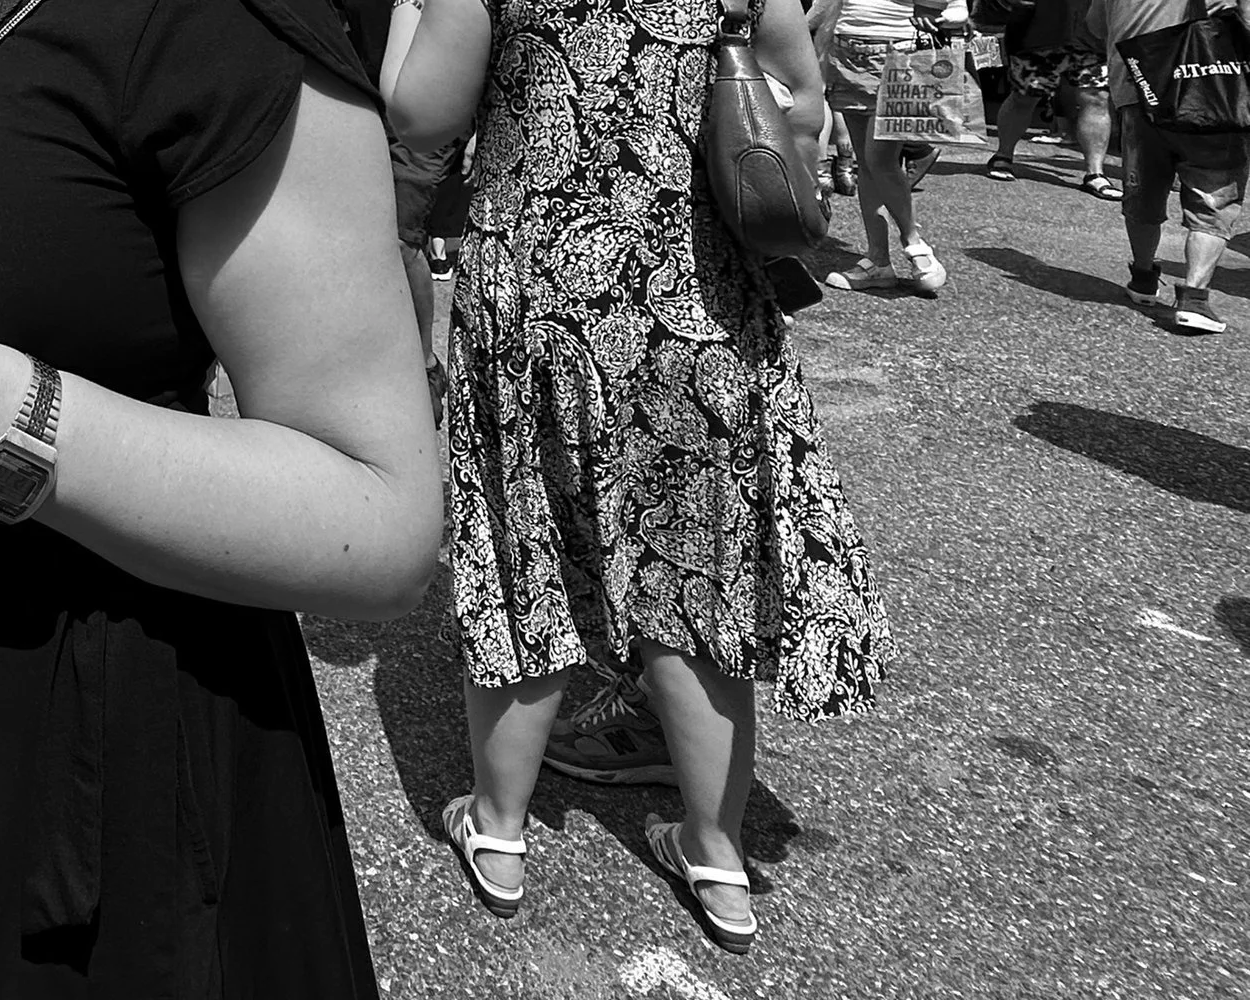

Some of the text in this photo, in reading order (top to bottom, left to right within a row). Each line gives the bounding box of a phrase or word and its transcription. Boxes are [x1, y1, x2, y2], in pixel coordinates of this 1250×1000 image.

[888, 68, 913, 83] IT'S
[886, 84, 944, 99] WHAT'S
[885, 101, 932, 116] NOT IN
[884, 119, 913, 133] THE
